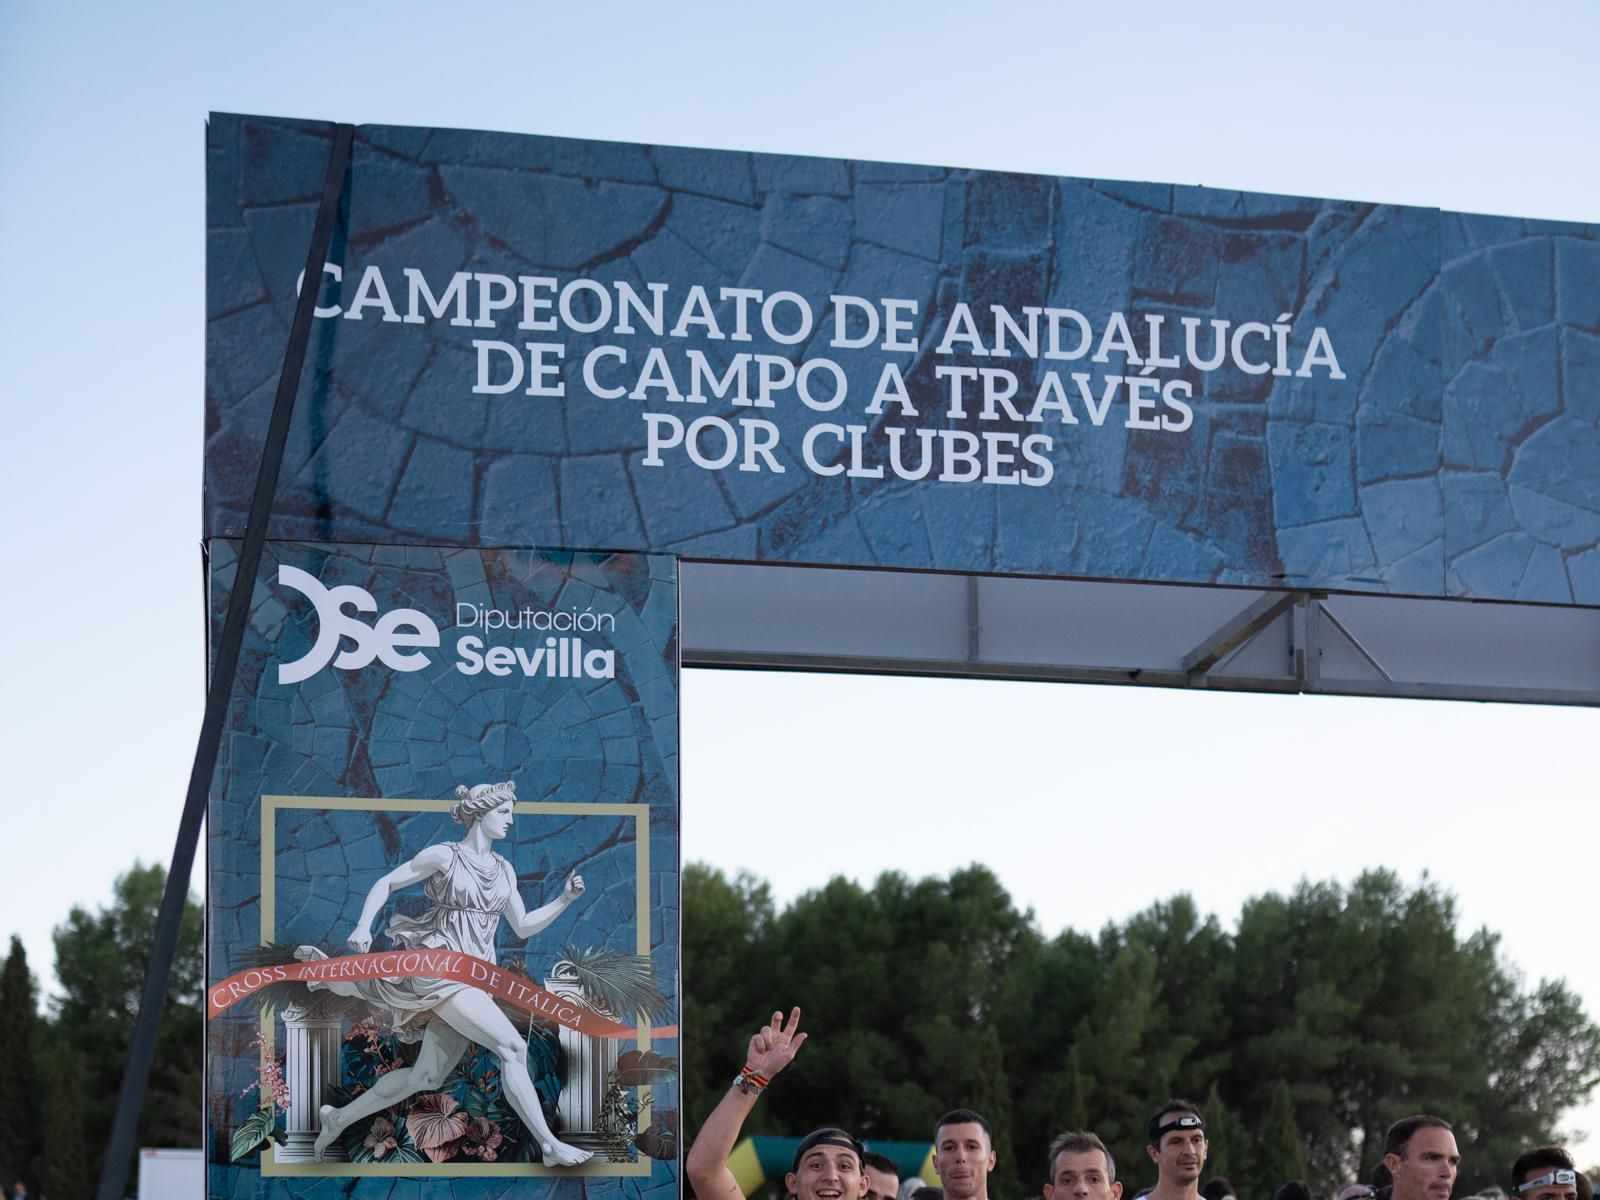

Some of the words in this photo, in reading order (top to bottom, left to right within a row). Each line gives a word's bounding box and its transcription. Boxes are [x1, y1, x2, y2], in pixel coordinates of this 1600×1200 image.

[296, 261, 813, 345] CAMPEONATO
[830, 295, 919, 353] DE
[935, 303, 1346, 380] ANDALUCÍA
[471, 339, 565, 397] DE
[583, 346, 847, 411] CAMPO
[866, 363, 919, 418] A
[935, 365, 1193, 432] TRAVÉS
[642, 412, 785, 473] POR
[802, 424, 1054, 487] CLUBES
[456, 602, 615, 634] Diputación
[456, 635, 615, 679] Sevilla
[212, 965, 287, 1009] CROSS
[298, 953, 464, 979] INTERNACIONAL
[470, 961, 501, 988] DE
[508, 981, 582, 1027] ITÁLICA
